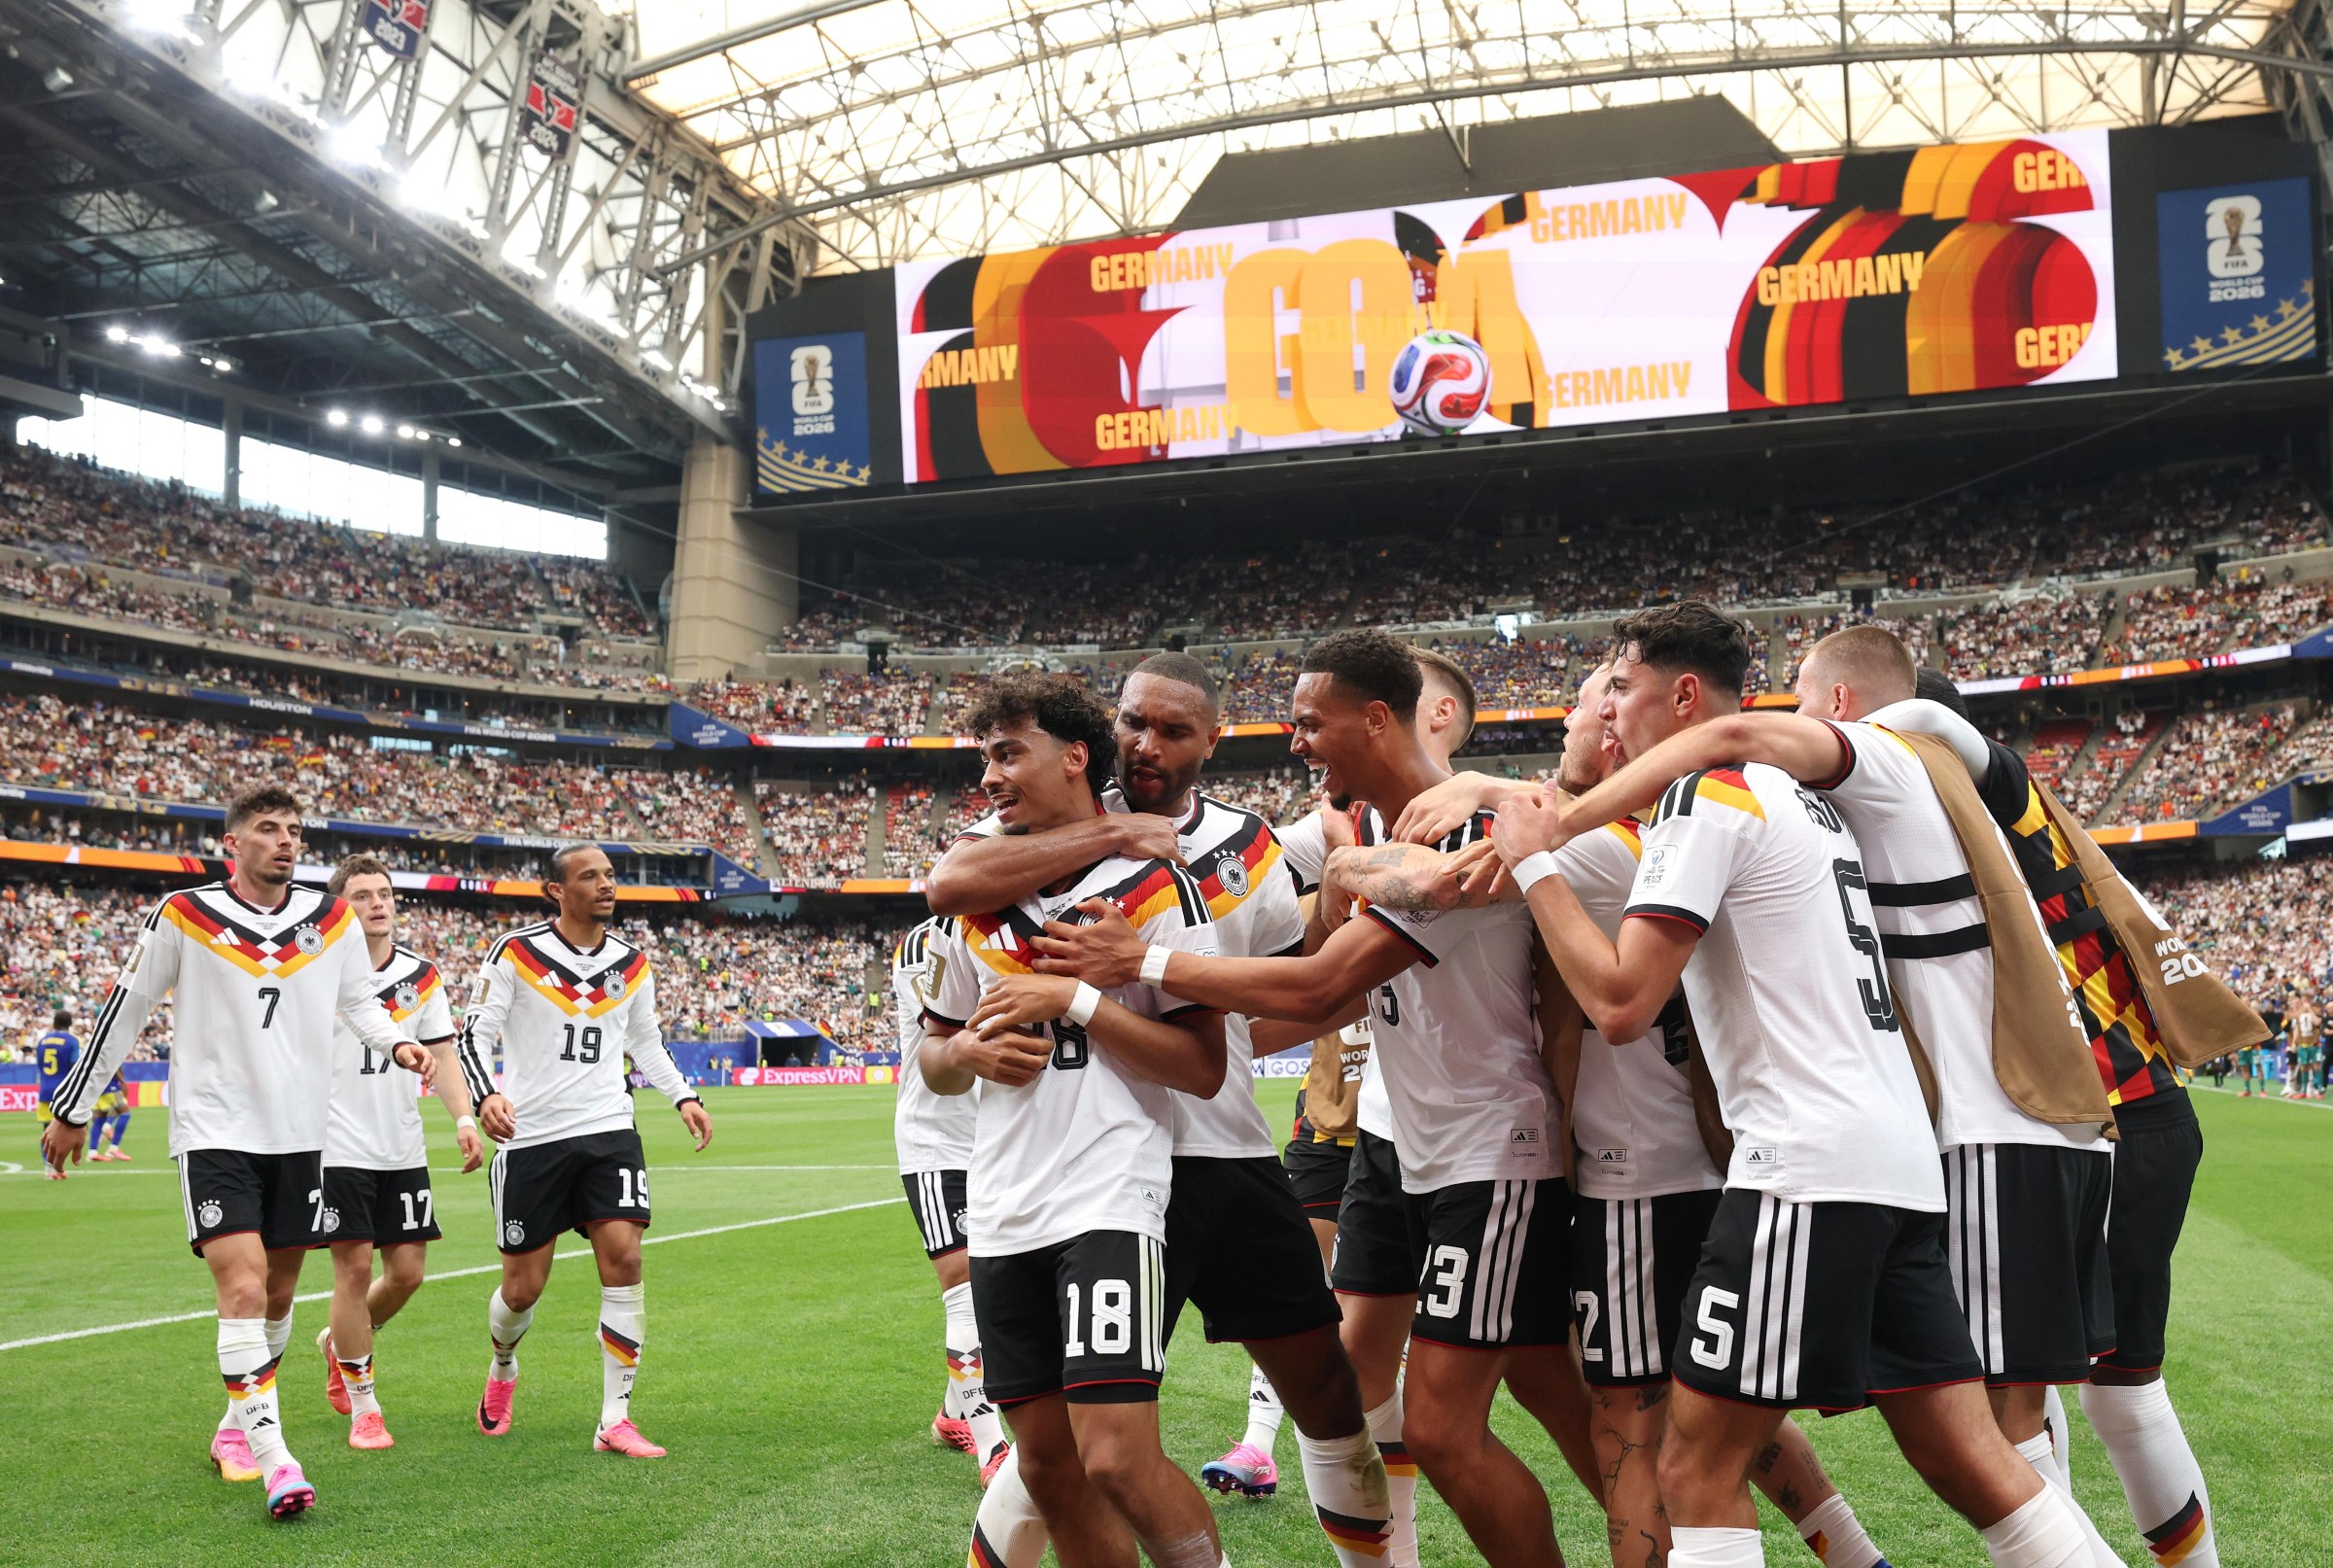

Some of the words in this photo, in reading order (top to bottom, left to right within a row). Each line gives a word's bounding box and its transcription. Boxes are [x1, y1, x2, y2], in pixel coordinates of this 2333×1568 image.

[374, 17, 406, 52] 2023
[529, 120, 559, 152] 2024
[2013, 150, 2089, 193] GER
[1531, 192, 1688, 244] GERMANY
[1090, 242, 1234, 293] GERMANY
[1757, 251, 1925, 306] GERMANY
[2223, 259, 2248, 269] FIFA
[2245, 275, 2265, 286] CUP
[2208, 285, 2266, 303] 2026
[804, 400, 823, 408] FIFA
[792, 422, 836, 436] 2026
[1096, 403, 1240, 451] GERMANY
[249, 697, 313, 715] HOUSTON
[464, 725, 482, 736] FIFA
[482, 728, 510, 739] WORLD
[510, 730, 527, 740] CUP
[527, 731, 557, 743] 2026
[1644, 875, 1663, 885] PEACE
[1832, 857, 1899, 1032] 5
[258, 987, 281, 1028] 7
[559, 1023, 603, 1063] 19
[43, 1048, 59, 1076] 5
[763, 1068, 862, 1086] ExpressVPN
[618, 1167, 650, 1209] 19
[308, 1188, 322, 1233] 7
[400, 1188, 434, 1231] 17
[1065, 1278, 1132, 1359] 18
[1689, 1285, 1740, 1371] 5
[245, 1402, 270, 1415] DFB
[962, 1386, 986, 1400] DFB
